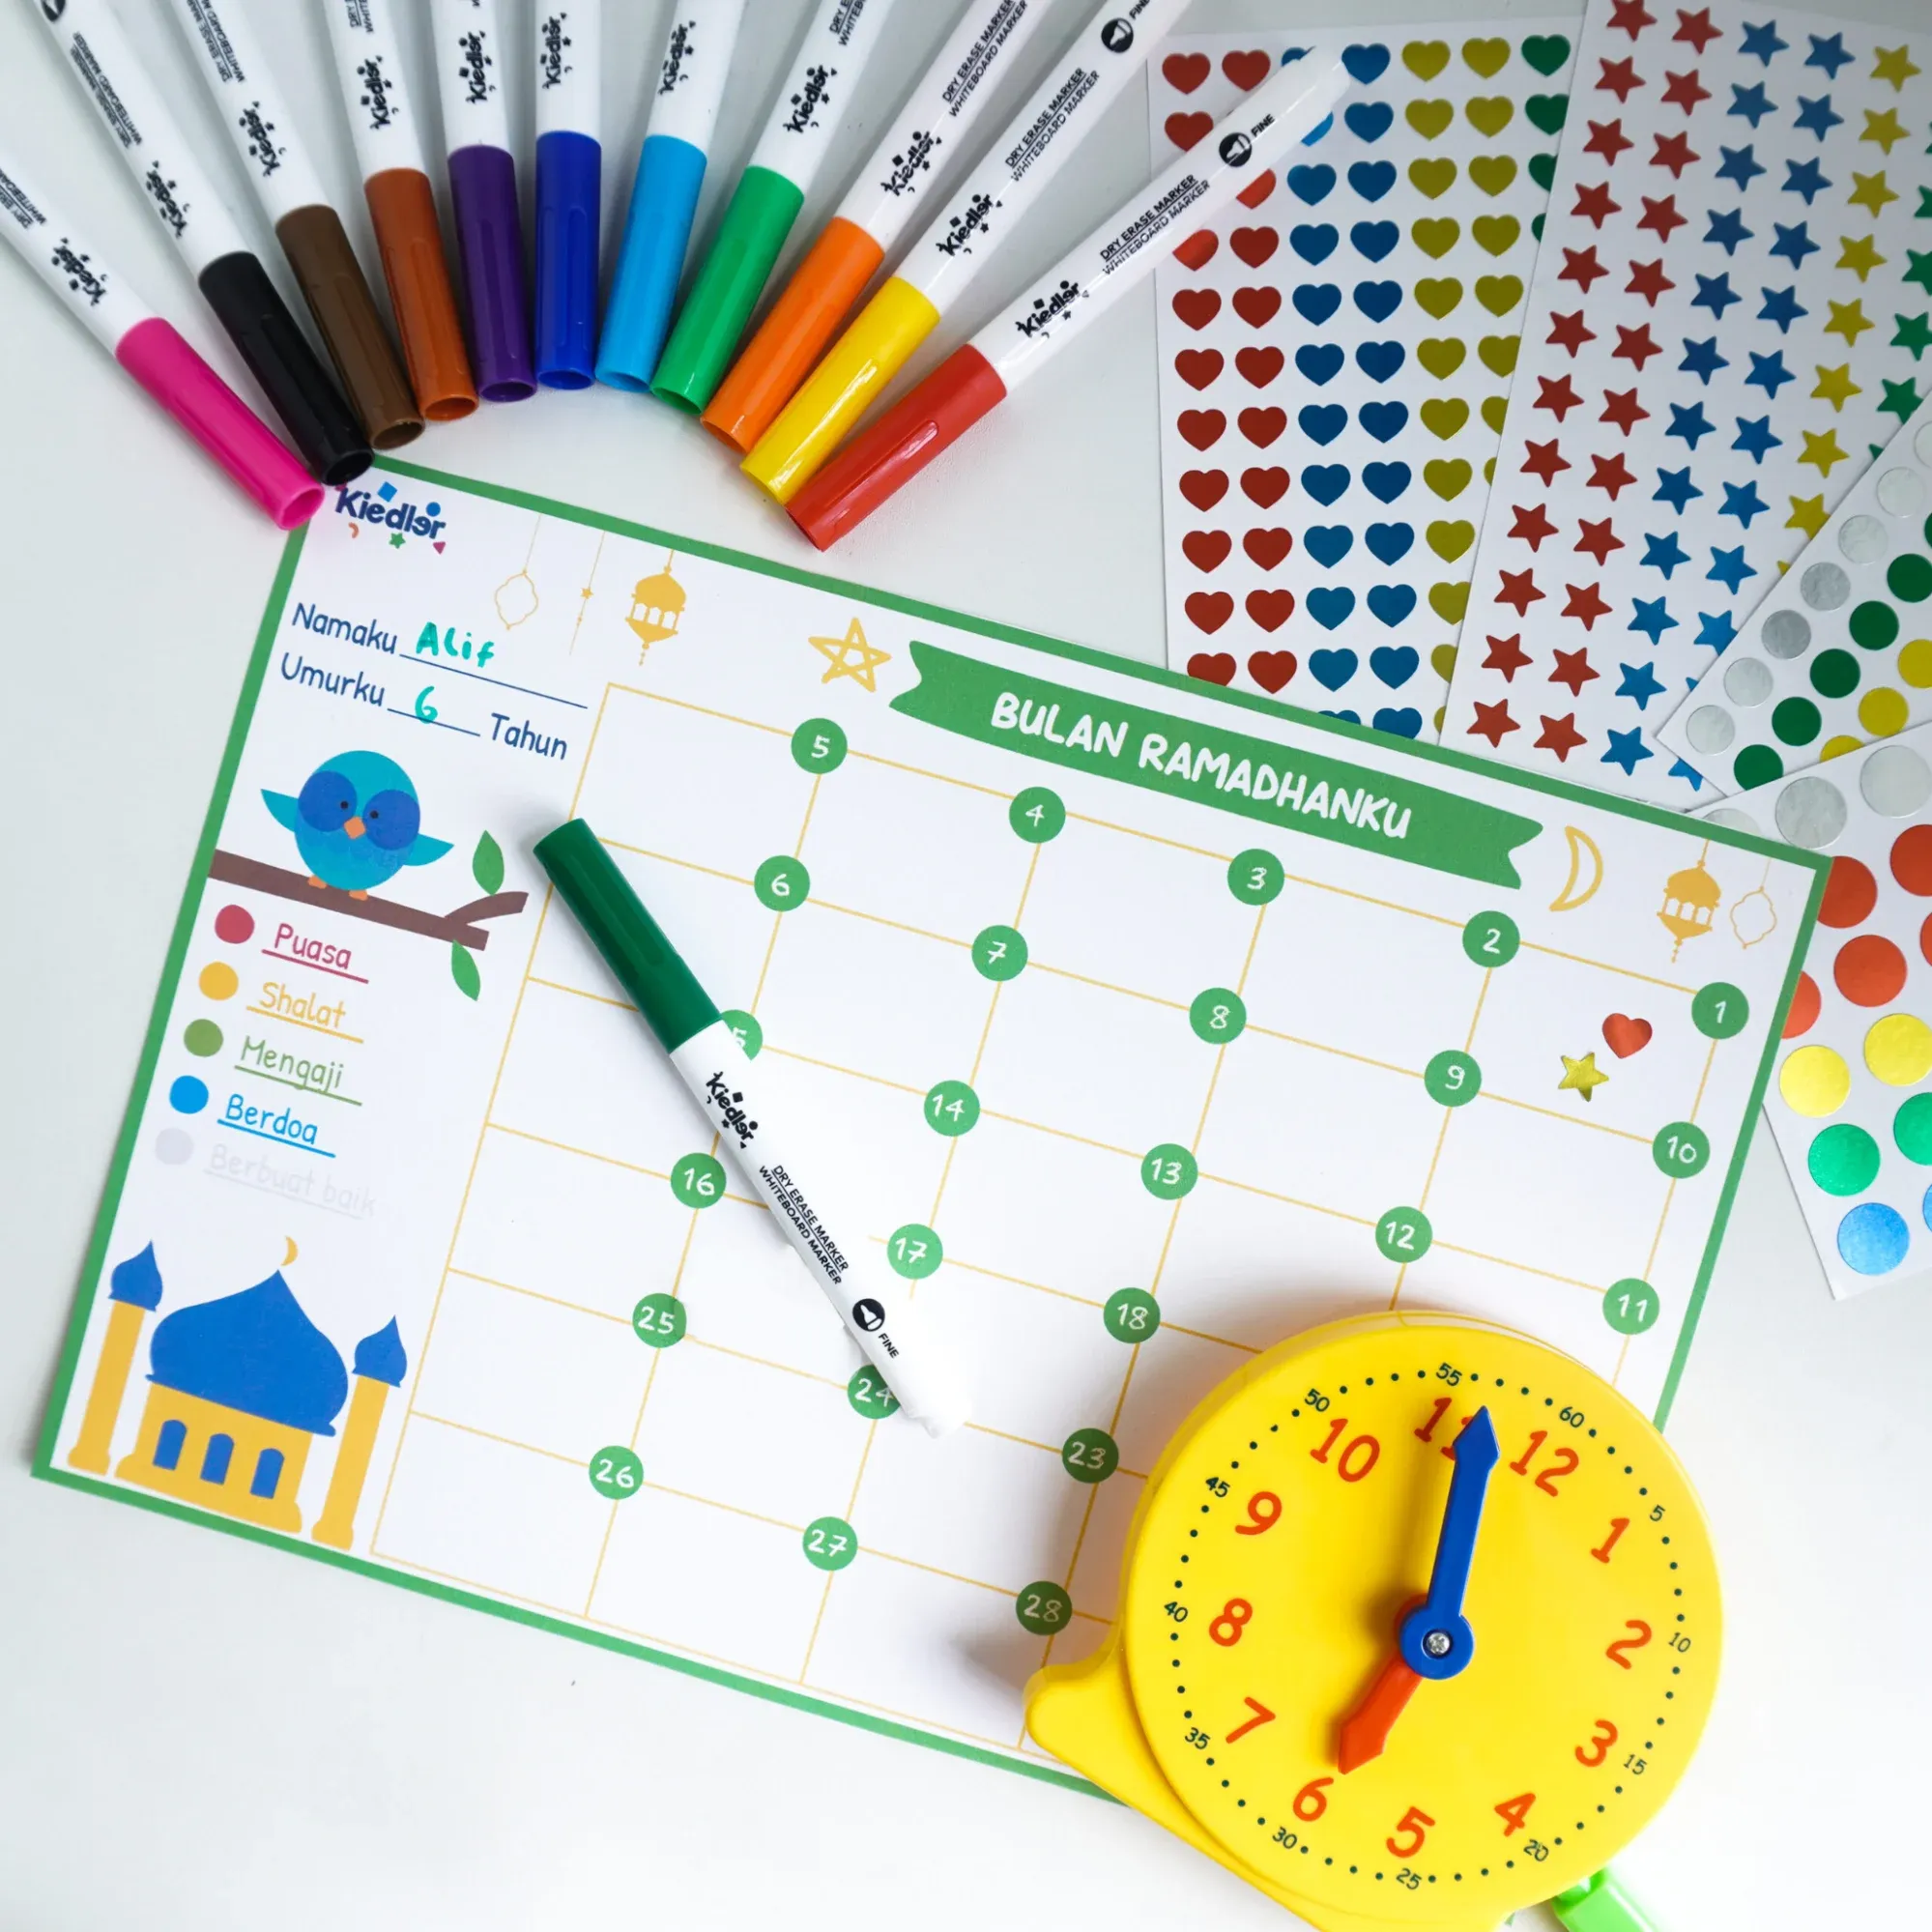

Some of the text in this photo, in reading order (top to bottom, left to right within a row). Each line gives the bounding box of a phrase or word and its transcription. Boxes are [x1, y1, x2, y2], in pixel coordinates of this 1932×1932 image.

[829, 8, 844, 33] DRY
[838, 0, 867, 45] WHITEB
[198, 22, 218, 59] ERASE
[207, 11, 245, 82] WHITEBOARD
[949, 0, 1027, 117] WHITEBOARD MARKER
[216, 61, 230, 82] DRY
[942, 77, 960, 103] DRY
[957, 42, 984, 78] ERASE
[99, 74, 142, 145] WHITEBOARD
[783, 65, 829, 133] Kiedler
[1005, 68, 1084, 167] DRY ERASE MARKER
[1011, 70, 1099, 182] WHITEBOARD MARKER
[1251, 113, 1275, 138] FINE
[880, 131, 934, 196] Kiedler
[0, 169, 46, 224] WHITEBOA
[937, 194, 995, 256] Kiedler
[1100, 174, 1197, 261] DRY ERASE MARKER
[1103, 179, 1210, 274] WHITEBOARD MARKER
[1016, 282, 1080, 337] Kiedler
[335, 486, 447, 539] Kiedler
[292, 602, 397, 654] Namaku
[281, 652, 385, 706] Umurku
[415, 685, 438, 724] 6
[491, 712, 567, 760] Tahun
[811, 735, 830, 759] 5
[991, 692, 1412, 839] BULAN RAMADHANKU
[1024, 804, 1045, 827] 4
[770, 873, 791, 897] 6
[1247, 866, 1268, 890] 3
[274, 923, 352, 969] Puasa
[986, 940, 1007, 965] 7
[1482, 928, 1501, 955] 2
[259, 981, 346, 1028] Shalat
[1209, 1004, 1230, 1030] 8
[1714, 1000, 1728, 1024] 1
[241, 1035, 344, 1093] Mengaji
[1445, 1064, 1466, 1090] 9
[224, 1093, 318, 1144] Berdoa
[706, 1070, 755, 1141] Kiedler
[931, 1093, 966, 1122] 14
[1667, 1136, 1697, 1165] 10
[210, 1143, 376, 1218] Berbuat baik
[682, 1167, 716, 1197] 16
[1150, 1157, 1184, 1186] 13
[759, 1165, 842, 1285] WHITEBOARD MARKER
[773, 1165, 849, 1272] DRY ERASE MARKER
[1384, 1221, 1417, 1251] 12
[894, 1237, 929, 1265] 17
[637, 1305, 675, 1335] 25
[1116, 1302, 1150, 1331] 18
[1617, 1292, 1649, 1323] 11
[879, 1332, 900, 1359] FINE
[853, 1376, 897, 1408] 24
[1436, 1362, 1462, 1386] 55
[1305, 1389, 1330, 1412] 50
[1560, 1406, 1585, 1428] 60
[1067, 1440, 1107, 1470] 23
[1310, 1418, 1381, 1483] 10
[1509, 1429, 1579, 1497] 12
[594, 1458, 635, 1489] 26
[1205, 1476, 1230, 1498] 45
[1234, 1491, 1283, 1536] 9
[1649, 1504, 1665, 1523] 5
[807, 1527, 849, 1558] 27
[1591, 1517, 1629, 1563] 1
[1023, 1594, 1063, 1623] 28
[1164, 1600, 1189, 1623] 40
[1208, 1598, 1254, 1647] 8
[1605, 1620, 1652, 1669] 2
[1667, 1631, 1691, 1653] 10
[1184, 1727, 1211, 1750] 35
[1226, 1696, 1276, 1744] 7
[1575, 1719, 1618, 1768] 3
[1623, 1754, 1647, 1775] 15
[1292, 1776, 1334, 1822] 6
[1494, 1793, 1536, 1836] 4
[1272, 1827, 1298, 1849] 30
[1386, 1806, 1435, 1859] 5
[1523, 1838, 1549, 1861] 20
[1396, 1867, 1422, 1890] 25
